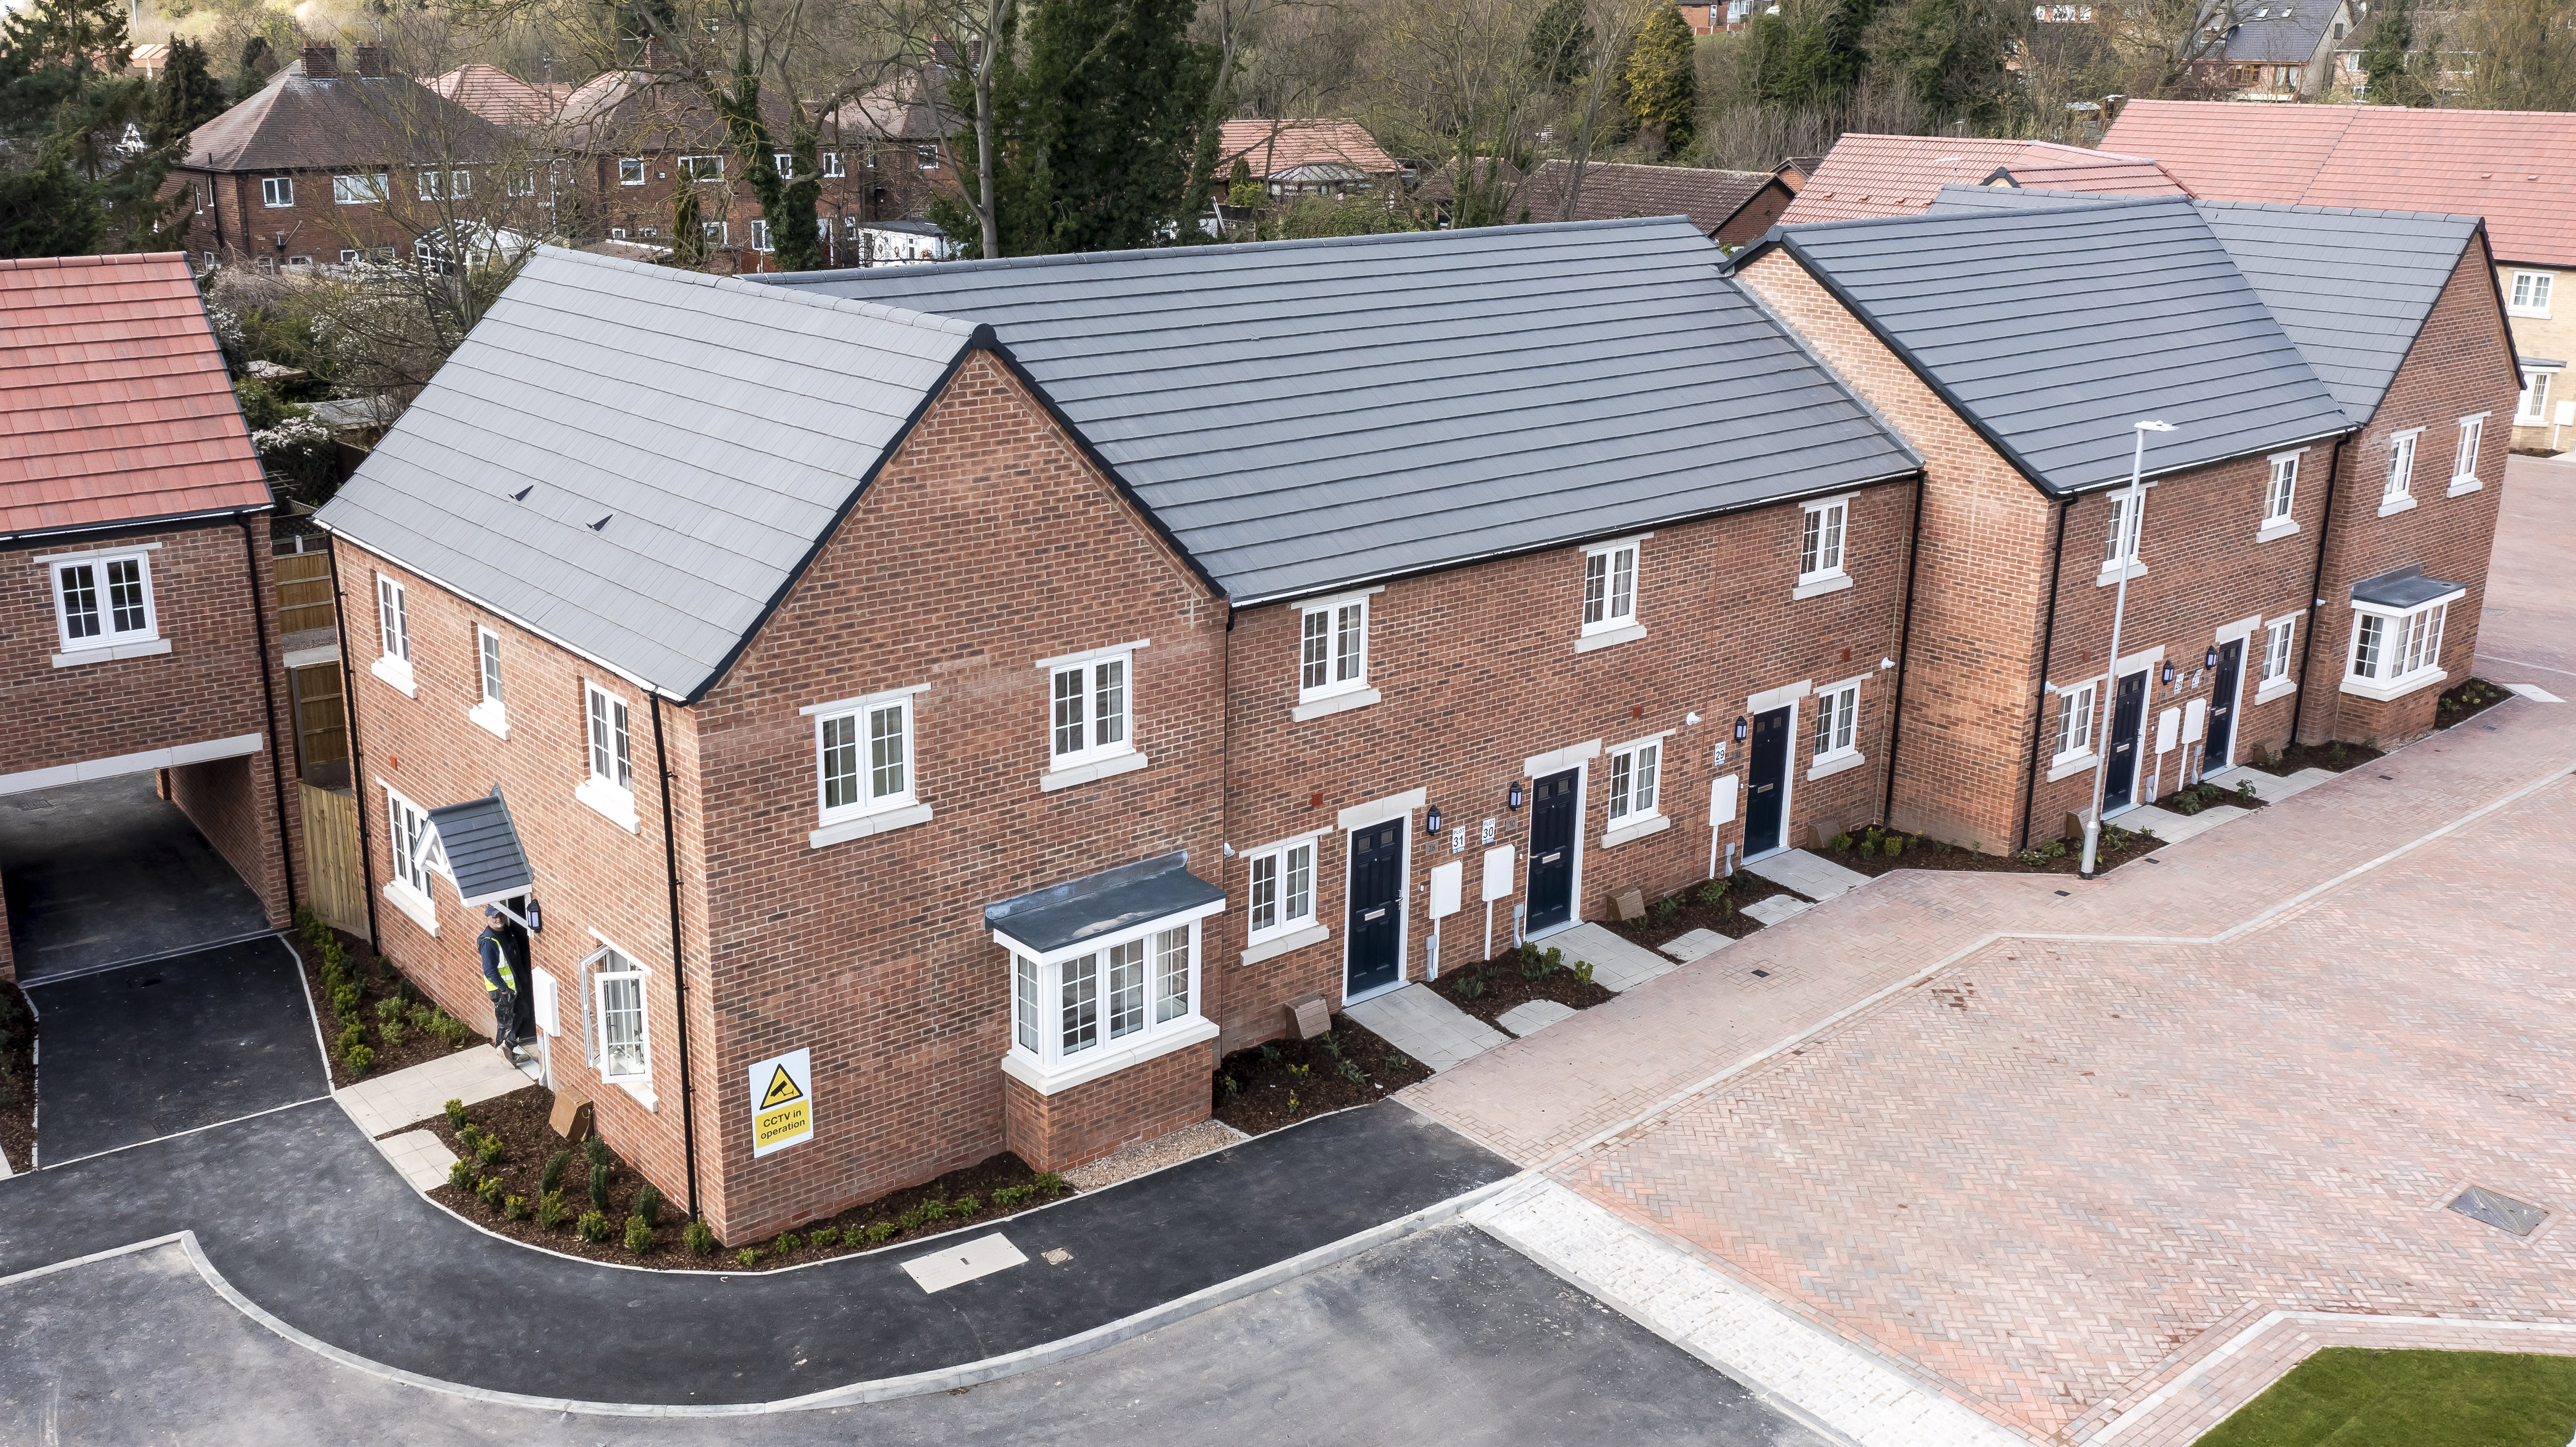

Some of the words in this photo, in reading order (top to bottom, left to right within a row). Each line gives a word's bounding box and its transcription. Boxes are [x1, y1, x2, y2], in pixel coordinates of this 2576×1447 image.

[2175, 681, 2182, 690] 28
[2193, 675, 2200, 684] 27
[1716, 750, 1724, 760] 29
[1483, 826, 1493, 839] 30
[1453, 835, 1463, 847] 31
[764, 1111, 790, 1127] CCTV
[761, 1120, 805, 1139] operation
